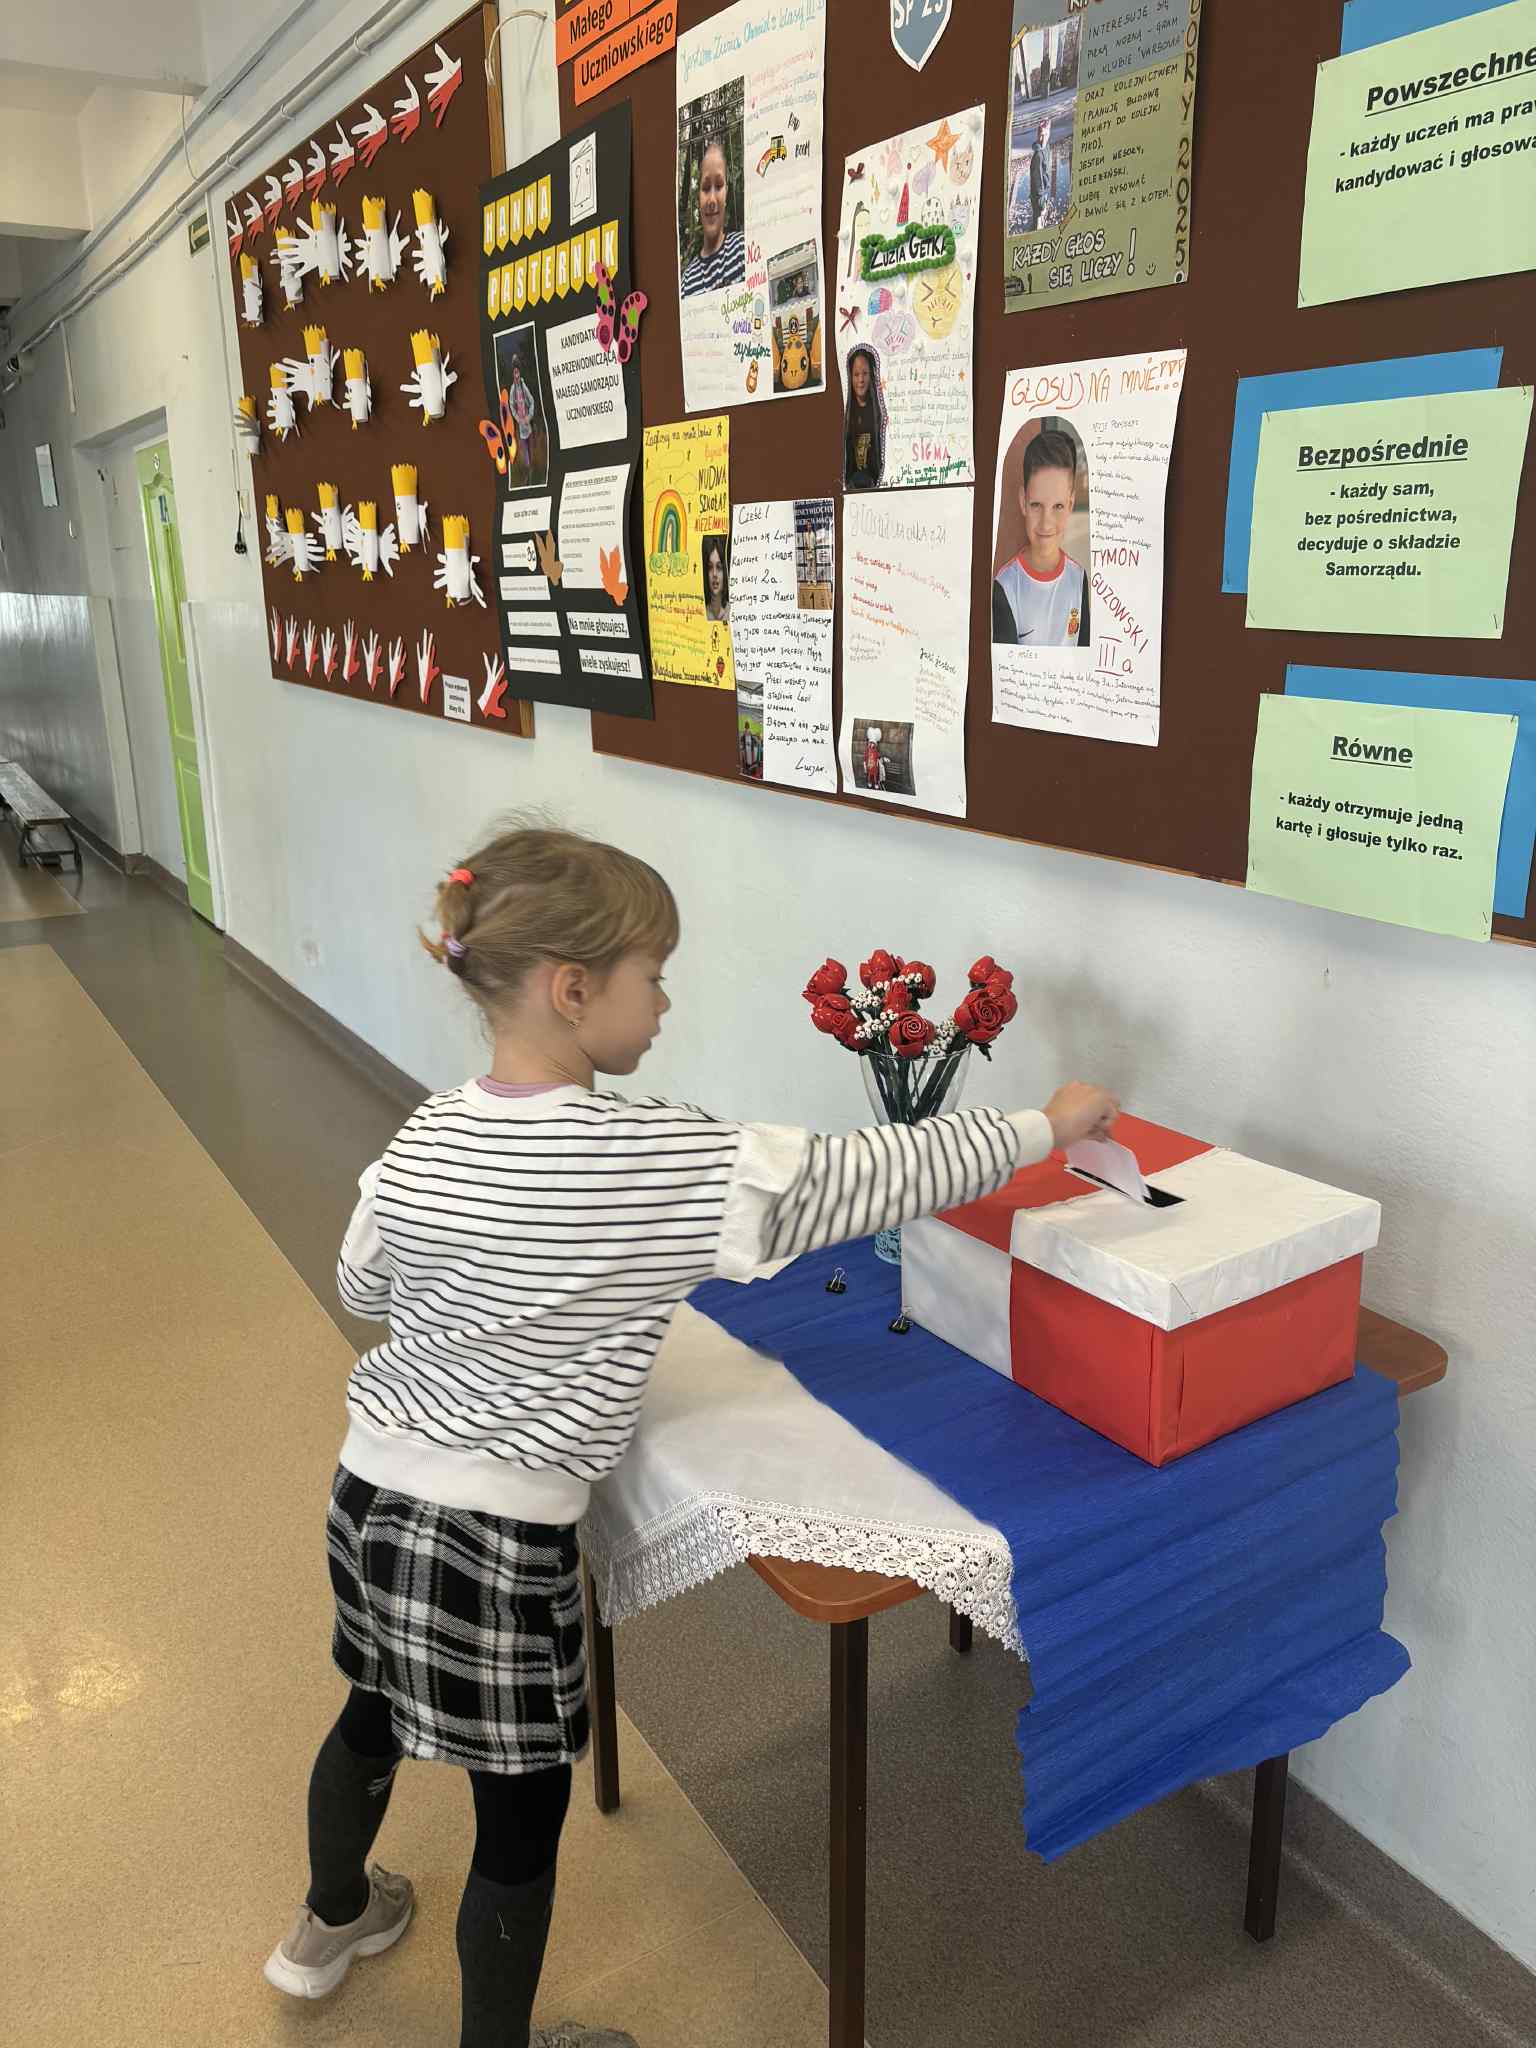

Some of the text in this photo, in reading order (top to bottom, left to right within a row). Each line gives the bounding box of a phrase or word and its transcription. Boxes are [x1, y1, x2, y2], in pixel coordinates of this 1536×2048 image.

[570, 0, 614, 45] Małego
[581, 12, 673, 86] Uczniowskiego
[1366, 47, 1536, 111] Powszechne
[1085, 88, 1105, 103] ORAZ
[1350, 133, 1400, 159] każdy
[1405, 115, 1459, 144] uczeń
[1465, 110, 1495, 129] ma
[1501, 99, 1536, 125] pra
[1078, 156, 1105, 171] JESTEM
[1335, 153, 1444, 193] kandydować
[1449, 150, 1455, 167] i
[485, 184, 547, 243] HANNA
[1012, 228, 1105, 271] KAŻDY GŁOS
[490, 230, 614, 309] PASTERNAK
[1048, 264, 1073, 289] SIĘ
[560, 328, 597, 350] KANDYDATK
[552, 349, 618, 377] NA PRZEWODNICZĄCĄ
[555, 374, 619, 401] MAŁEGO SAMORZĄDU
[1088, 368, 1112, 405] NA
[566, 399, 614, 421] UCZNIOWSKIEGO
[1298, 434, 1469, 469] Bezpośrednie
[699, 464, 727, 491] NUDNA
[1340, 483, 1388, 500] każdy
[1392, 482, 1434, 498] sam,
[1305, 507, 1458, 528] bez pośrednictwa,
[1091, 548, 1140, 567] TYMON
[1297, 534, 1461, 554] decyduje o składzie
[1325, 561, 1422, 580] Samorządu.
[1091, 572, 1148, 654] GUZOWSKI
[569, 618, 628, 637] Na mnie głosujesz,
[581, 655, 631, 674] wiele zyskujesz!
[1332, 735, 1414, 765] Równe
[1288, 792, 1330, 813] każdy
[1335, 800, 1413, 825] otrzymuje
[1416, 811, 1464, 834] jedną
[1276, 816, 1463, 860] kartę i głosuje tylko raz.
